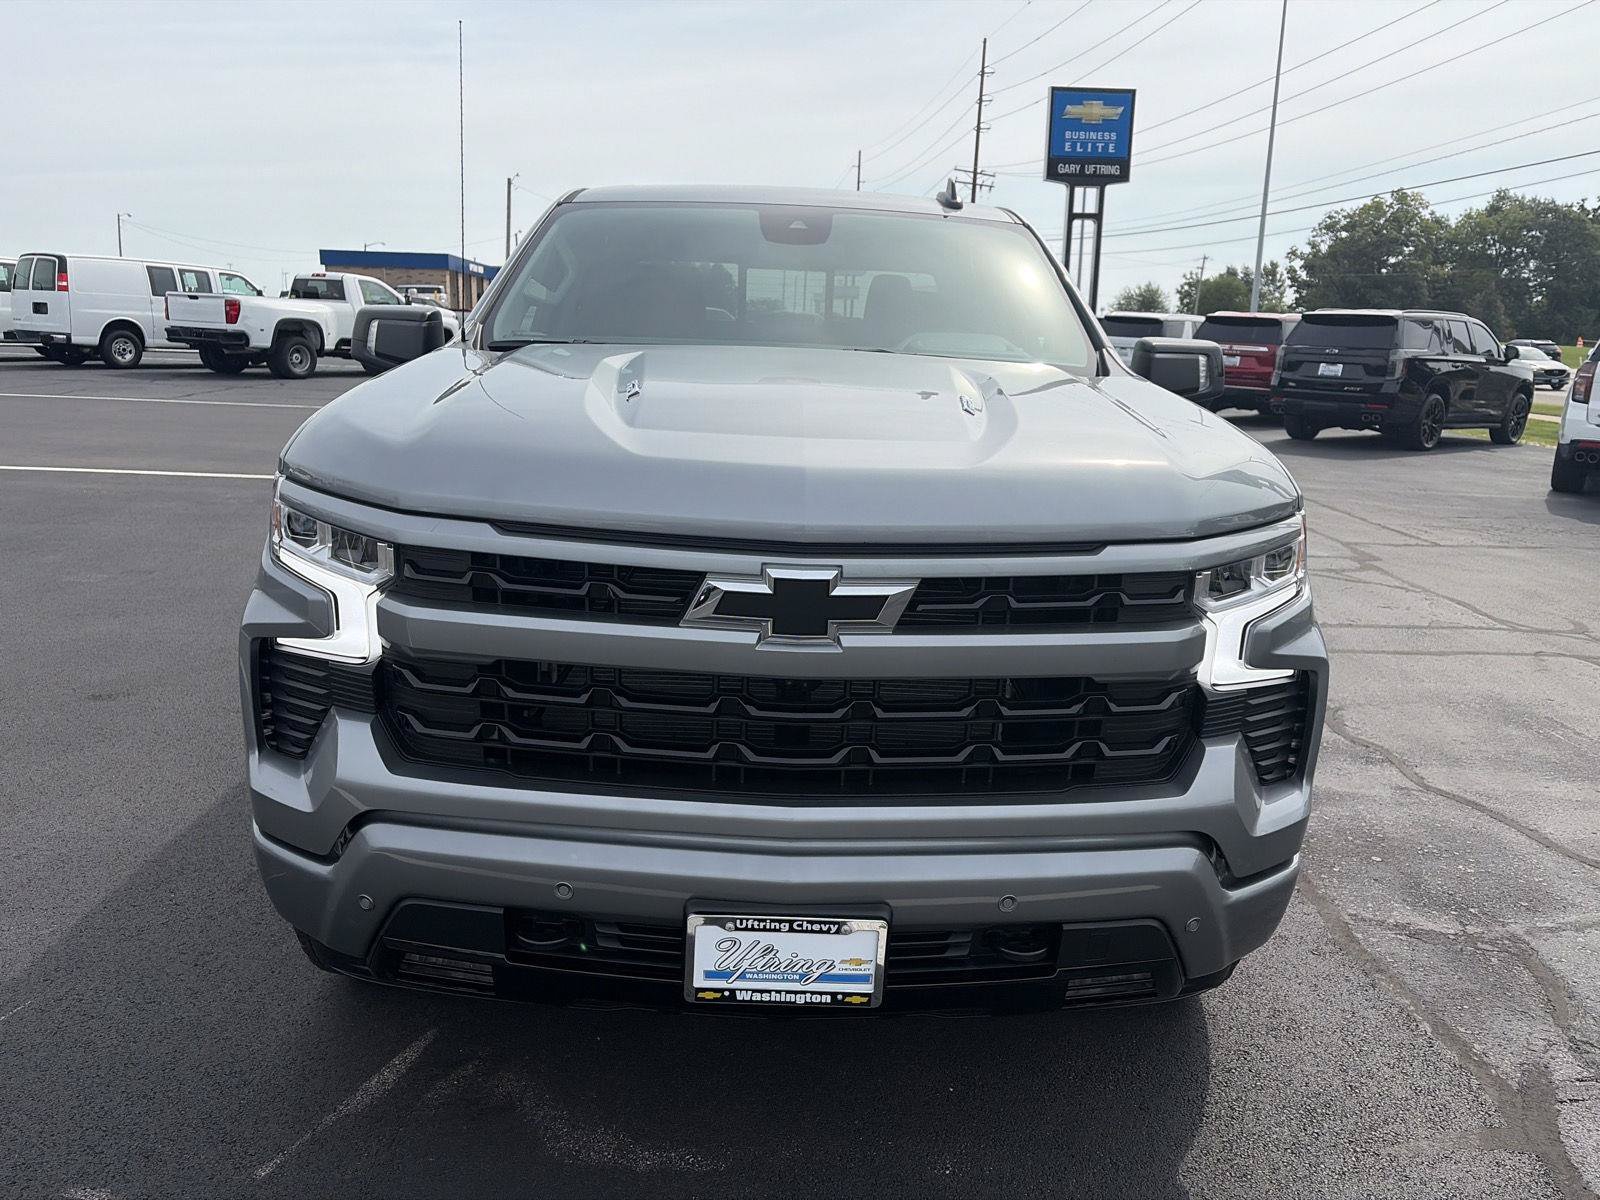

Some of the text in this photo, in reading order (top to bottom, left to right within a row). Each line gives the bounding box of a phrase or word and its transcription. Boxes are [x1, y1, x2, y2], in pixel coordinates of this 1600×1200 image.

[1065, 131, 1117, 140] BUSINESS
[1064, 142, 1116, 153] ELITE
[1057, 163, 1121, 175] GARY UFTRING
[735, 919, 839, 934] Uftring Chevy
[714, 936, 836, 987] Uftring
[735, 990, 832, 1004] Washington
